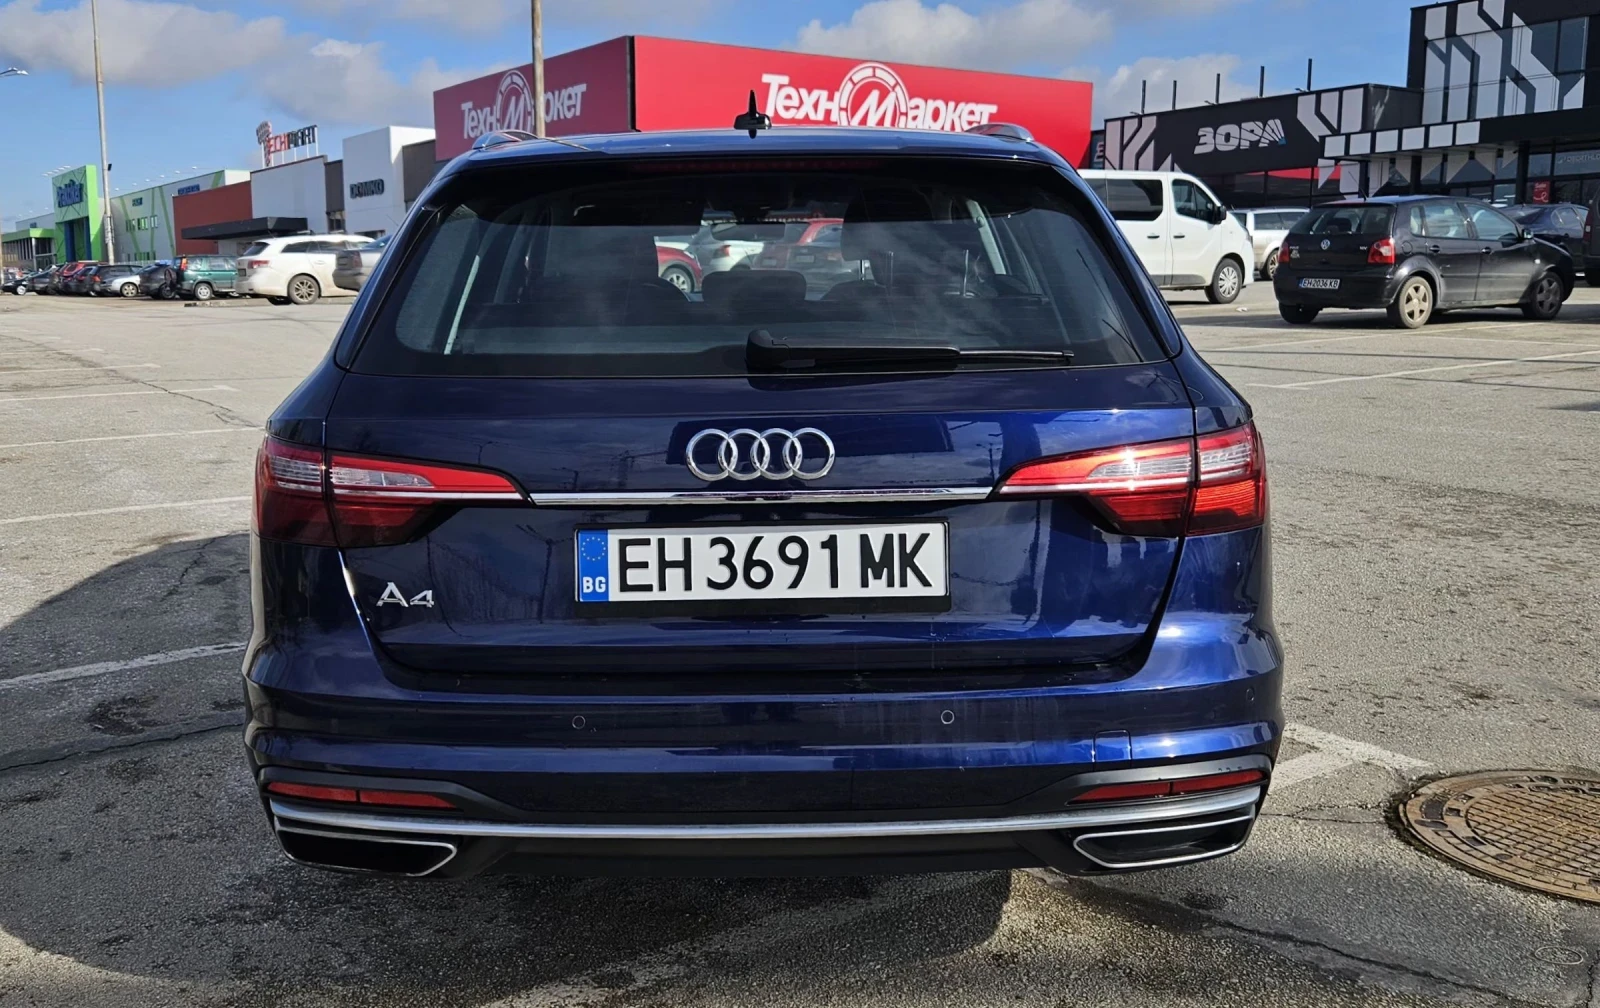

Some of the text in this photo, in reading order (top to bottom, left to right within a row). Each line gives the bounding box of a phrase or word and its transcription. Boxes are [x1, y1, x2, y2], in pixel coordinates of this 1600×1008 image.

[618, 532, 933, 593] EH 3691 MK
[376, 581, 435, 608] A4
[582, 576, 607, 594] BG
